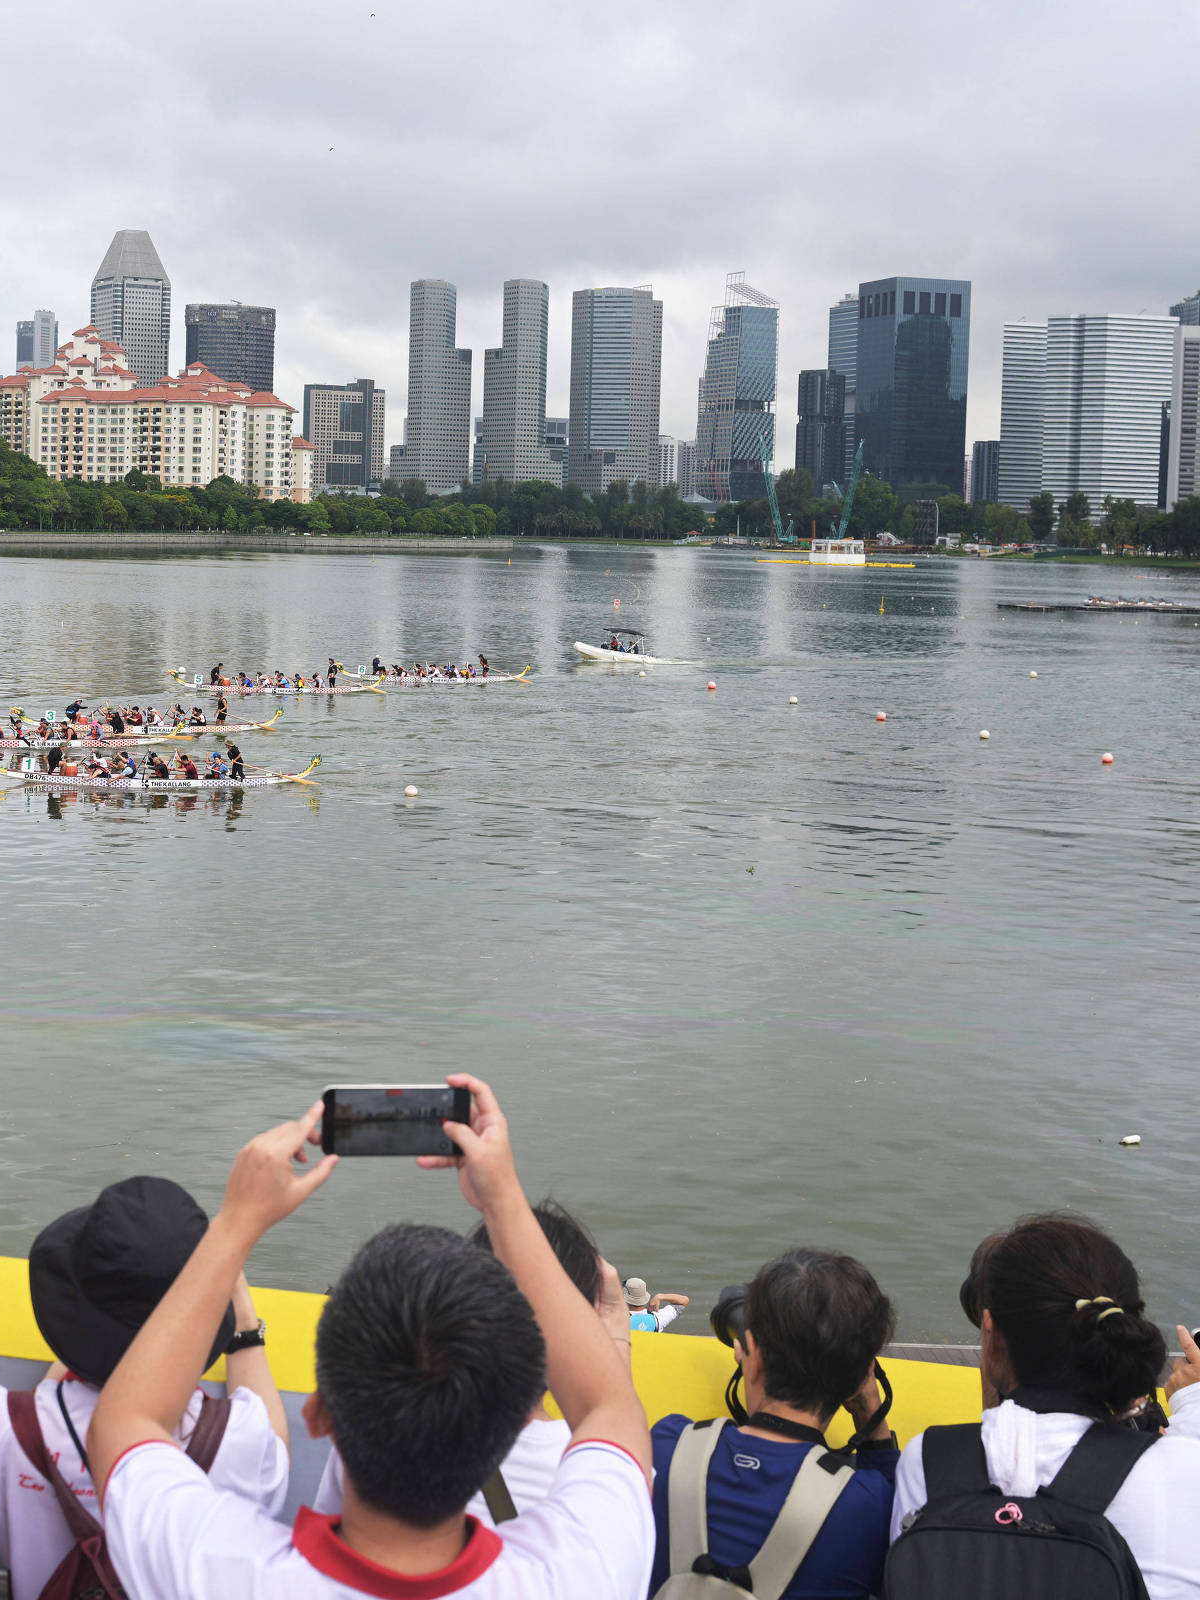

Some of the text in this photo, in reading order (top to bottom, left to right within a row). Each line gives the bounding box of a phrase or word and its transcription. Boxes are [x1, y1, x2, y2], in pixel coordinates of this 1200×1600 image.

[358, 665, 365, 674] 6
[195, 674, 202, 683] 5
[47, 711, 55, 721] 3
[24, 758, 32, 770] 1
[24, 773, 46, 781] DB476
